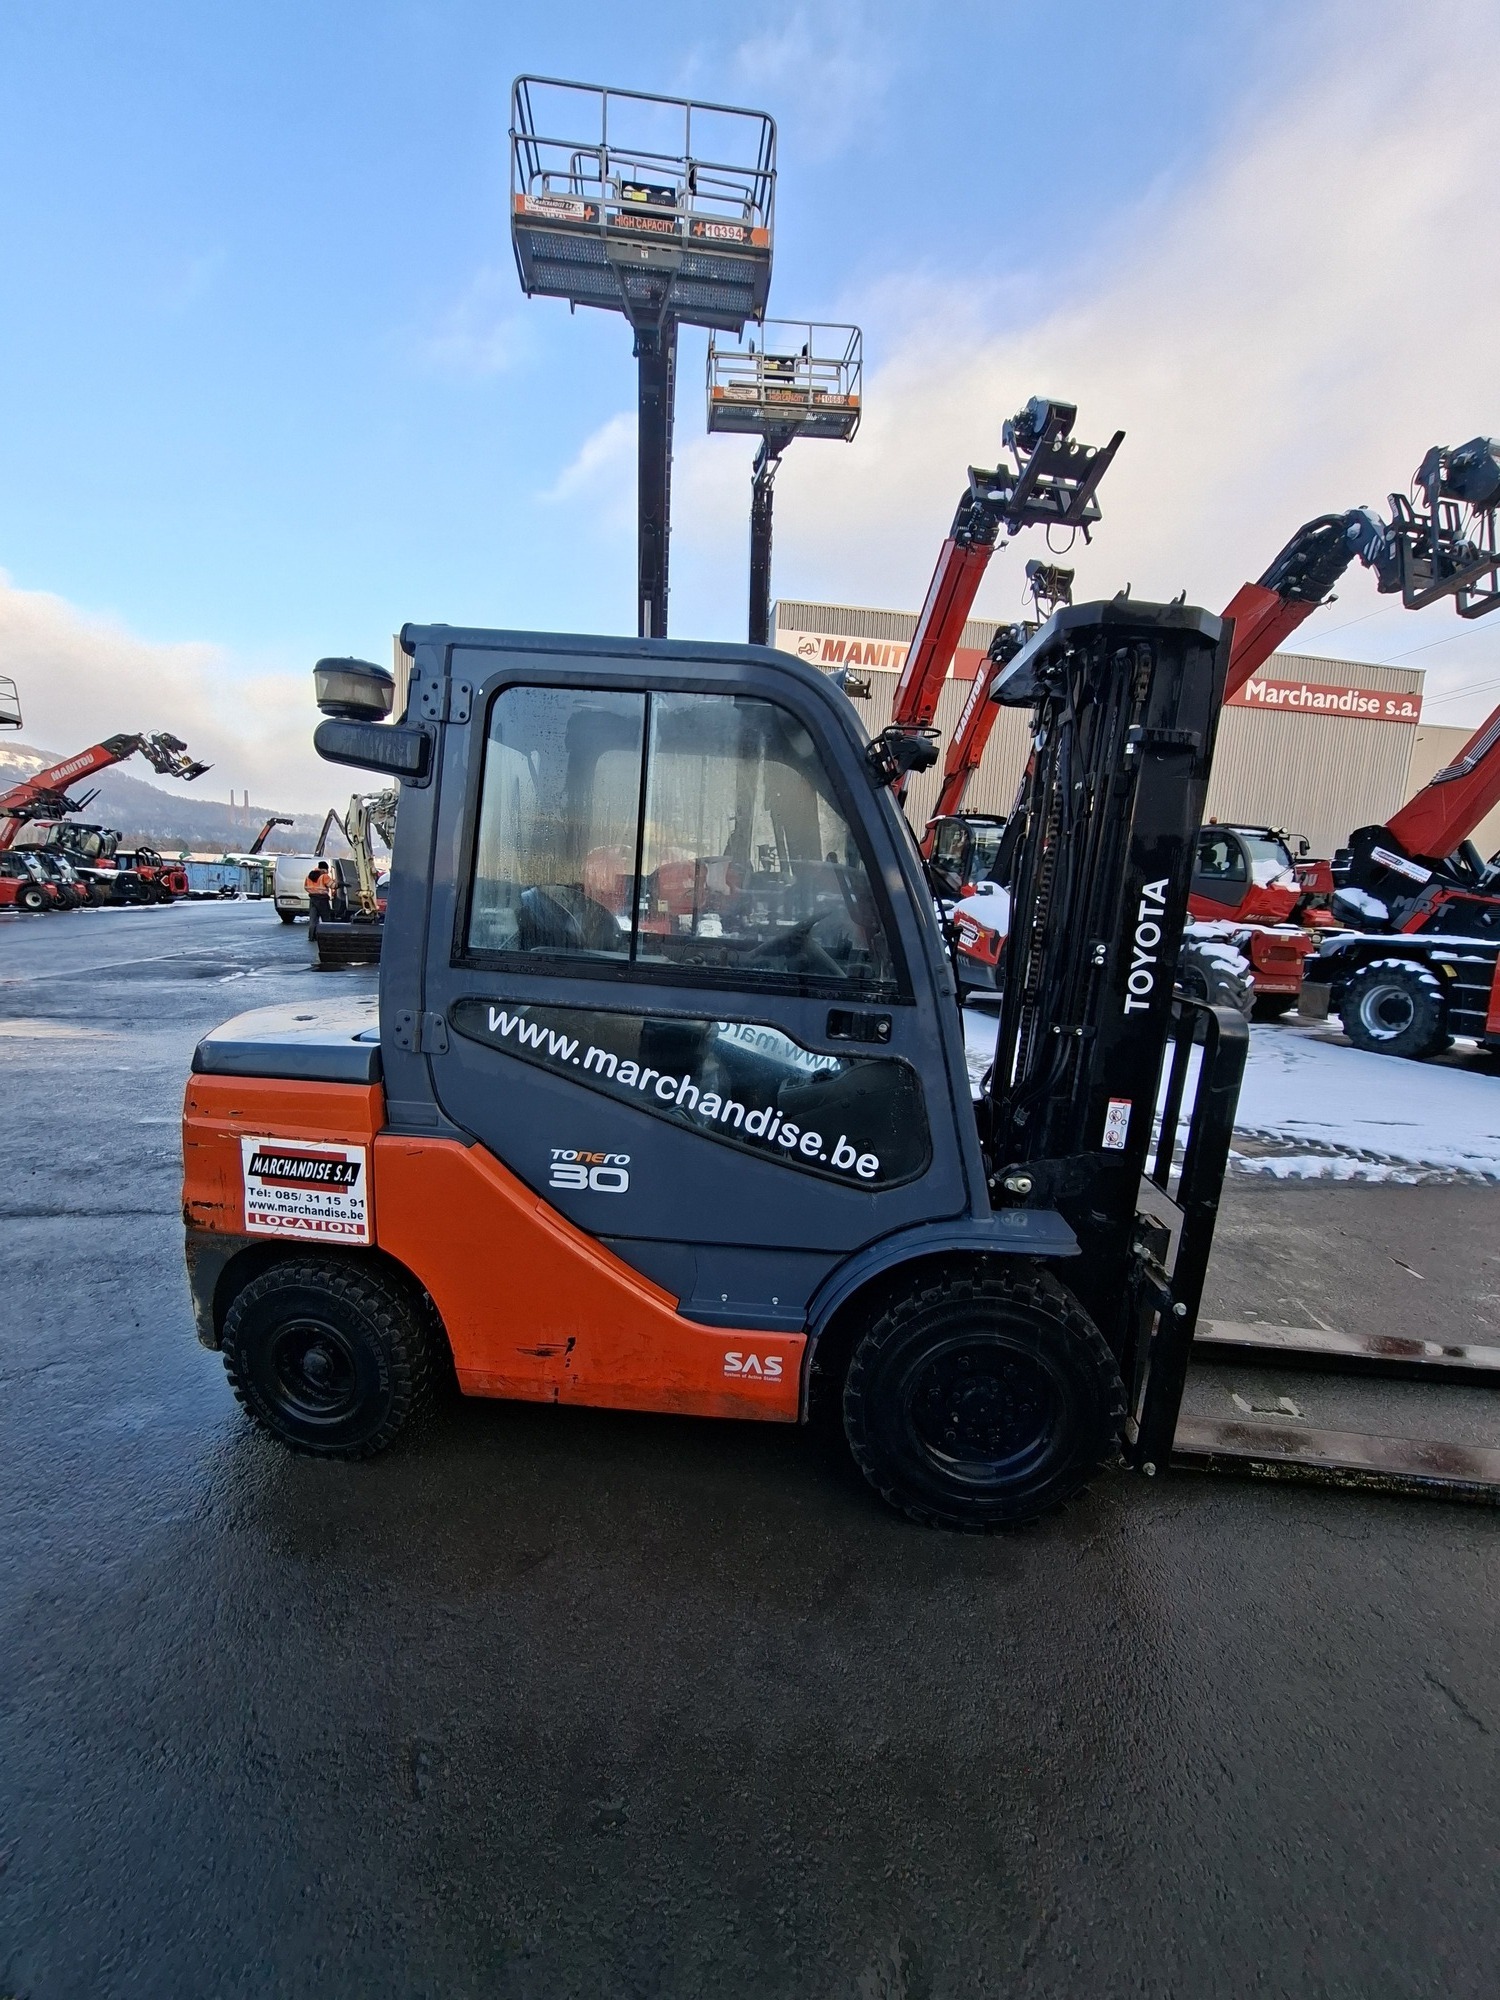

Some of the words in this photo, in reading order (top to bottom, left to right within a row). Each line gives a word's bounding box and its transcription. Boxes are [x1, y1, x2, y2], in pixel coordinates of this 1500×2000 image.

[614, 215, 634, 228] HIGH
[635, 218, 674, 233] CAPACITY
[707, 225, 742, 240] 10394
[821, 639, 909, 668] MANIT
[954, 669, 985, 745] MANITOU
[1245, 679, 1380, 713] Marchandise
[1385, 700, 1418, 717] s.a.
[51, 753, 95, 781] MANITOU
[1392, 895, 1456, 917] MRT
[1124, 878, 1170, 1015] TOYOTA
[488, 1006, 880, 1179] www.marchandise.be
[252, 1157, 332, 1180] MARCHANDISE
[333, 1165, 355, 1183] S.A.
[549, 1163, 630, 1193] 30
[248, 1188, 271, 1198] Tél:
[275, 1191, 301, 1201] 085/
[306, 1194, 320, 1203] 31
[326, 1196, 341, 1205] 15
[350, 1199, 364, 1208] 91
[248, 1201, 364, 1220] www.marchandise.be
[255, 1214, 358, 1234] LOCATION
[724, 1352, 783, 1375] SAS
